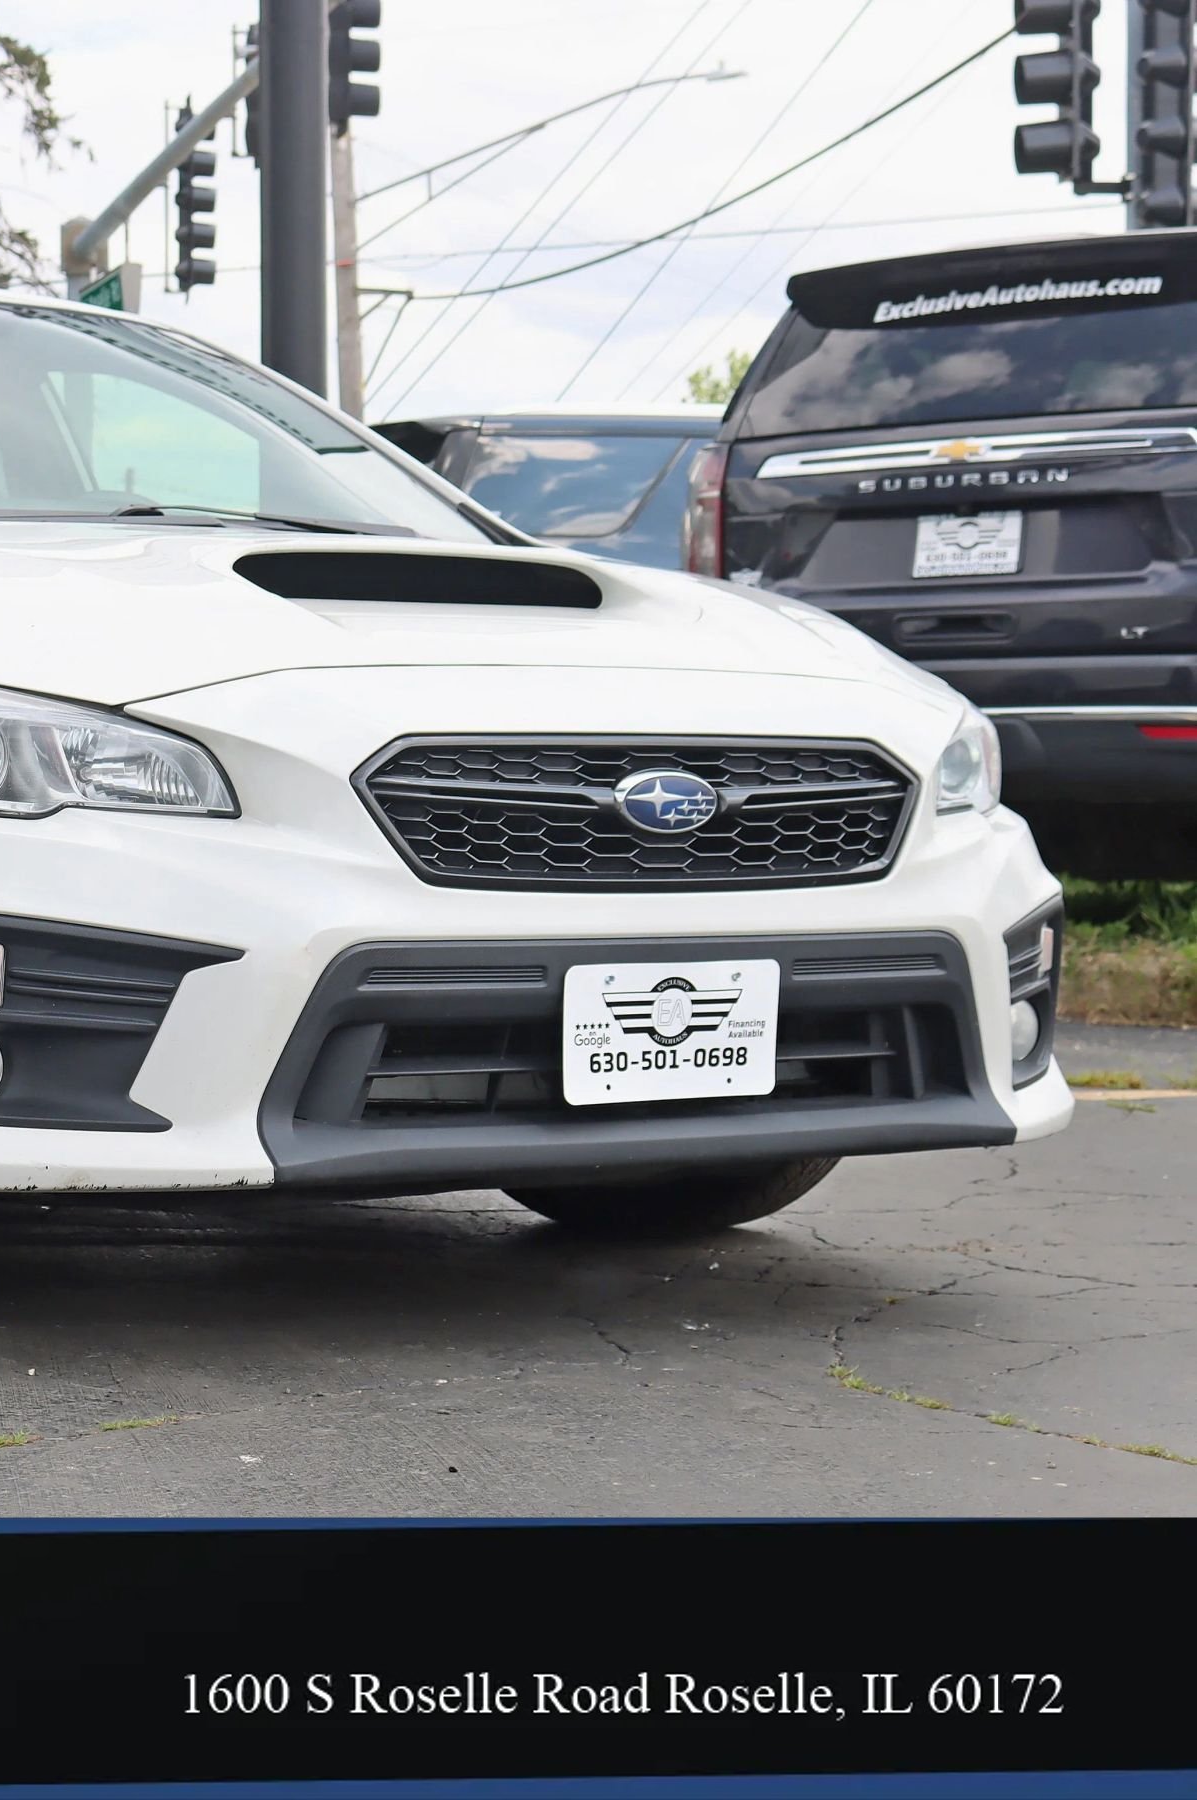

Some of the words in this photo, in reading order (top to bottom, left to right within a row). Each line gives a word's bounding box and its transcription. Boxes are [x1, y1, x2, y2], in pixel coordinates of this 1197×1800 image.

[873, 276, 1163, 323] ExclusiveAutohaus.com
[858, 468, 1069, 493] SUBURBAN
[1120, 625, 1149, 640] LT
[656, 978, 691, 992] EXCLUSIVE
[657, 998, 687, 1027] EA
[728, 1019, 766, 1029] Financing
[574, 1032, 611, 1049] Google
[652, 1031, 688, 1045] AUTOHAUS
[728, 1029, 764, 1039] Available
[589, 1046, 748, 1074] 630-501-0698
